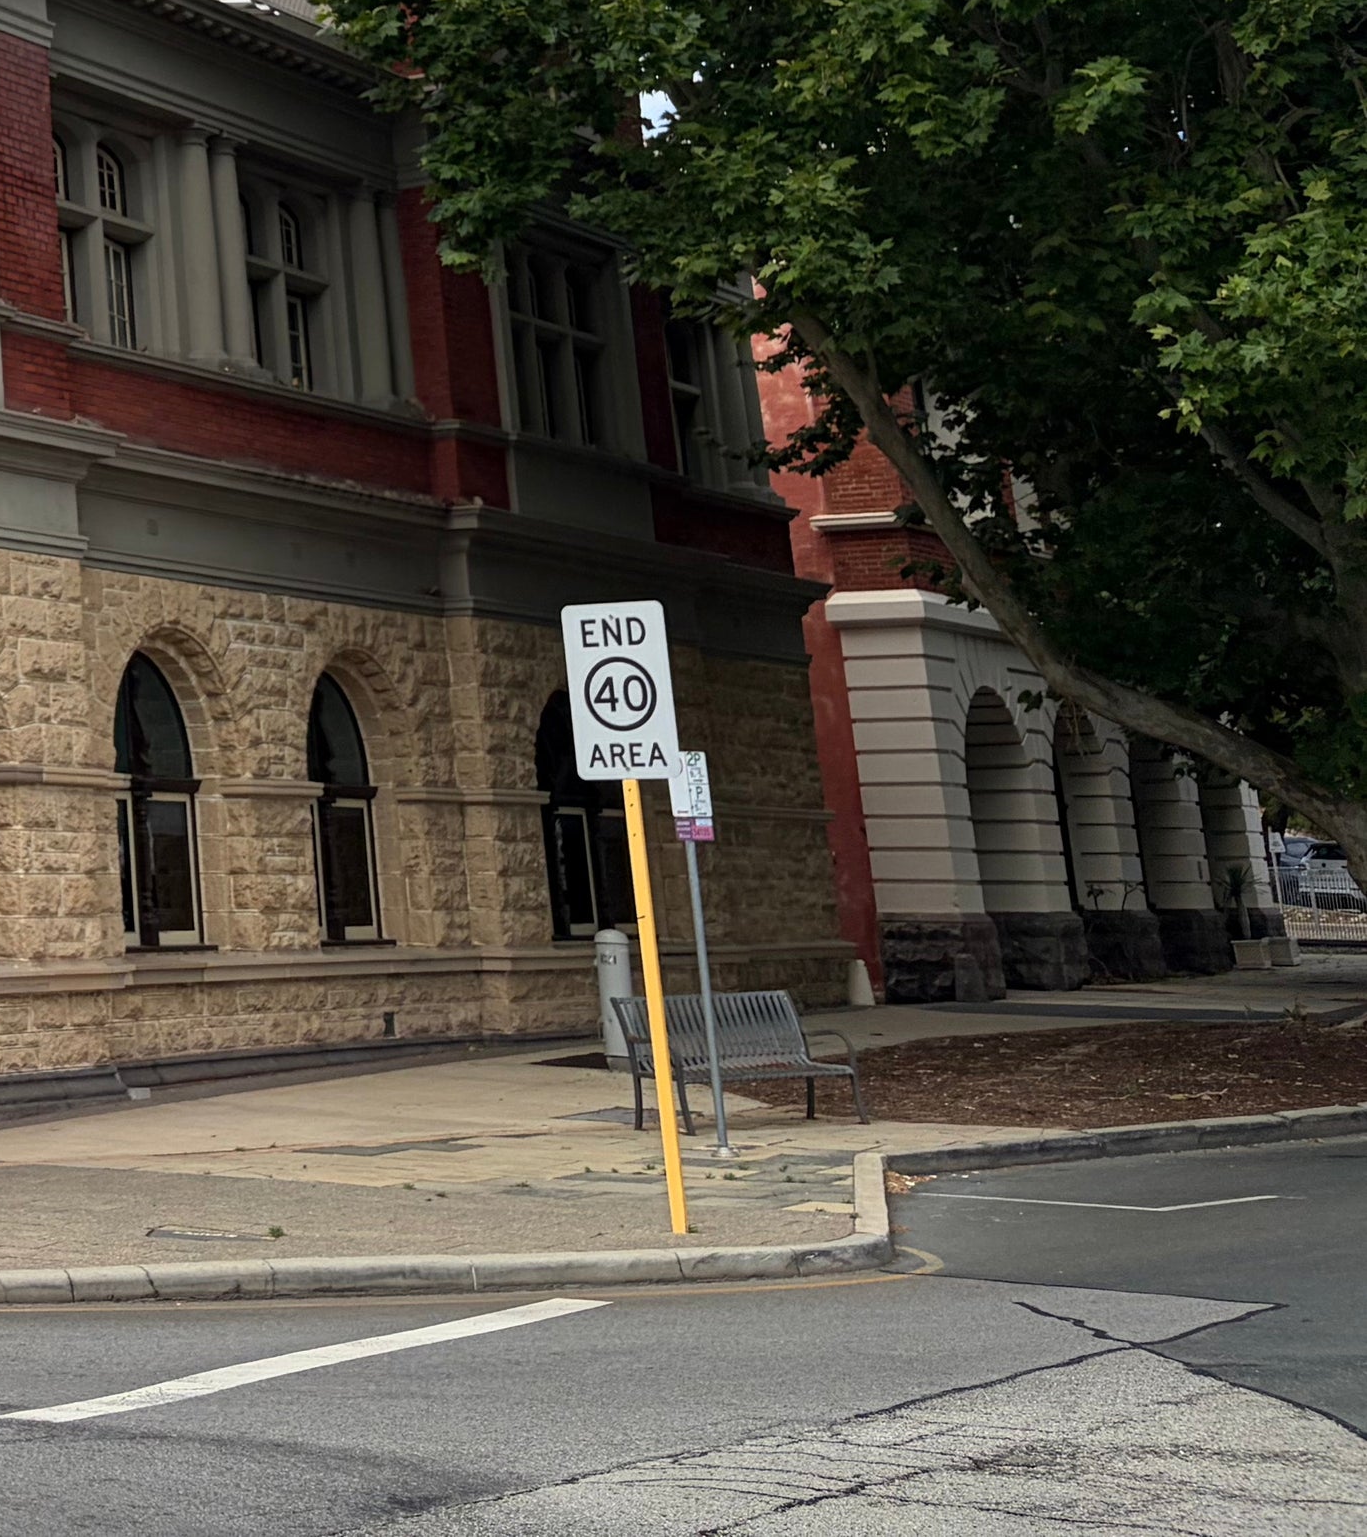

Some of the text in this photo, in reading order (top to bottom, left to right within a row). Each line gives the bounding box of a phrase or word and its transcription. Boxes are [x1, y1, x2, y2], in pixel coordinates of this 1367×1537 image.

[580, 617, 646, 648] END
[593, 675, 648, 712] 40
[589, 742, 668, 768] AREA
[686, 751, 701, 766] 2P
